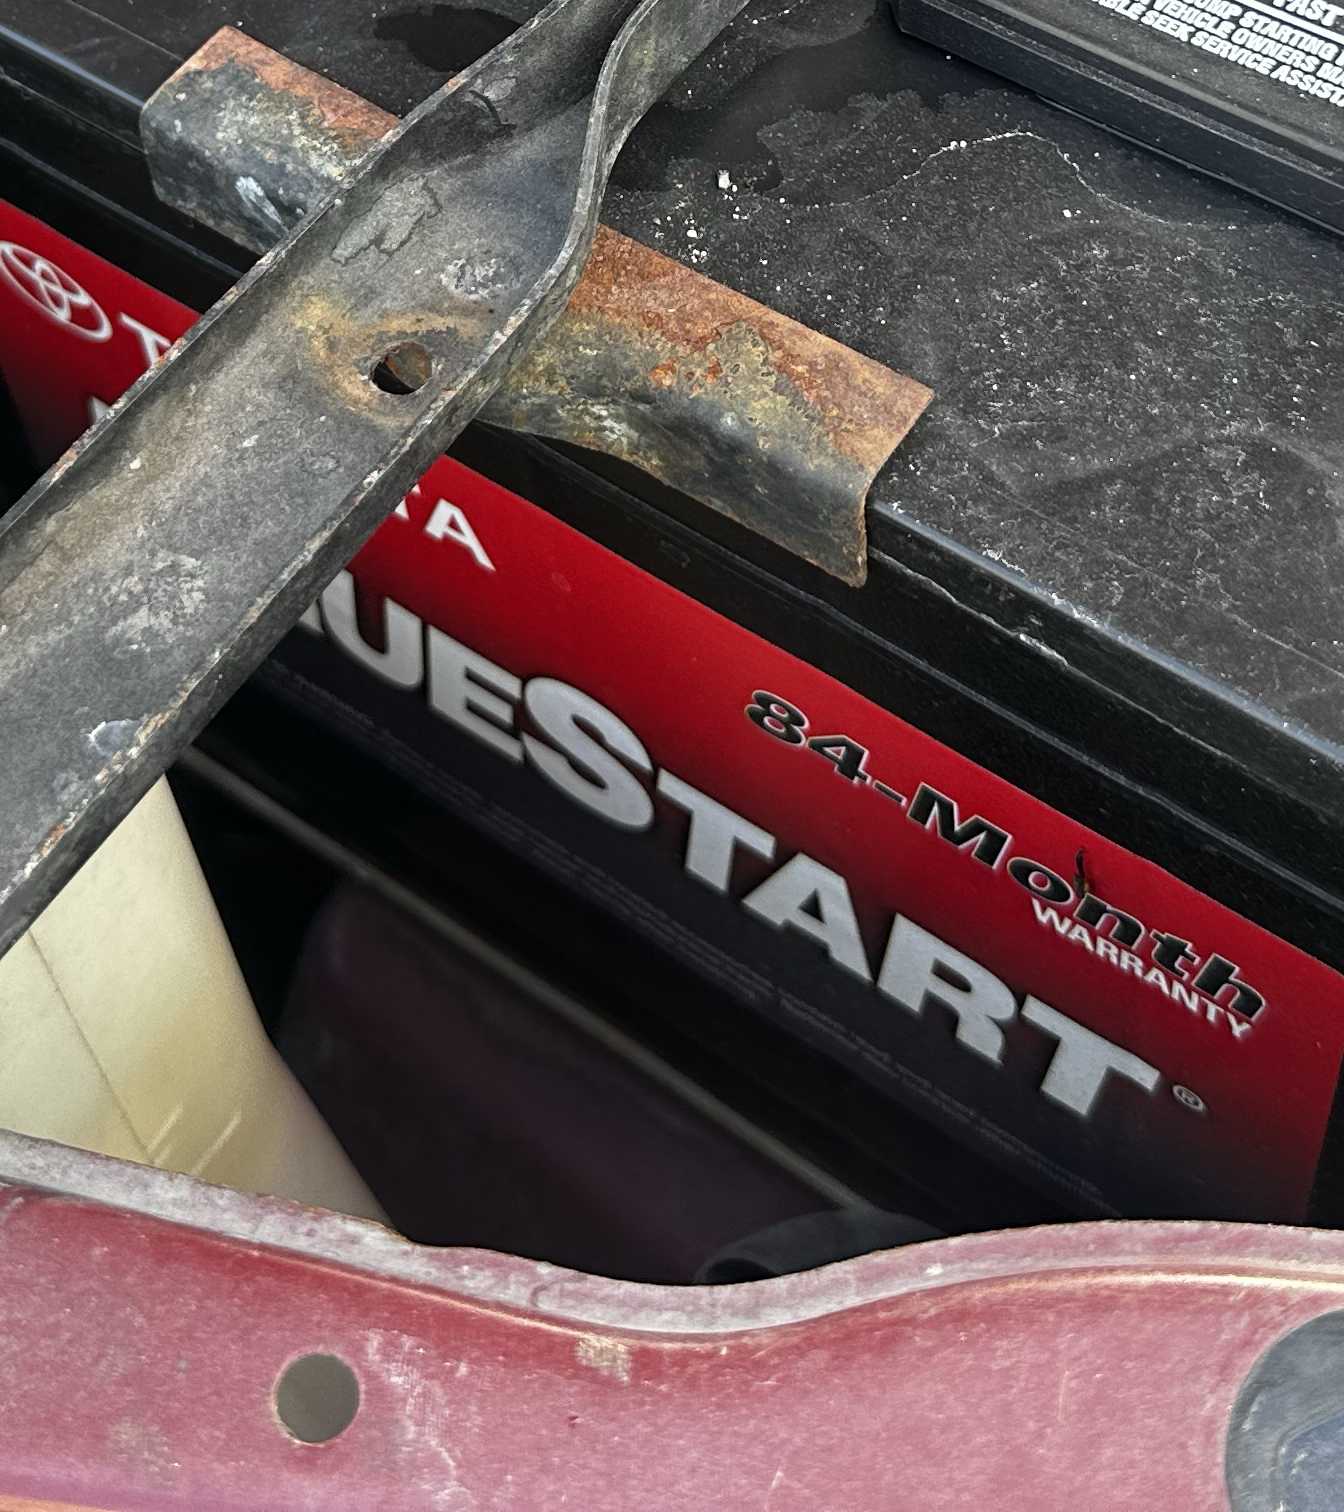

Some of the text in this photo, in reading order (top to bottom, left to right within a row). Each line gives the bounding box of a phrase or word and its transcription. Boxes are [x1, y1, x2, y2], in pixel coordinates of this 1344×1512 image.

[1142, 8, 1195, 41] SEEK
[1190, 31, 1277, 75] SERVICE
[1231, 28, 1320, 73] OWNERS
[1239, 11, 1339, 61] STARTING
[744, 689, 1266, 1021] 84-Month
[1031, 897, 1255, 1041] WARRANTY
